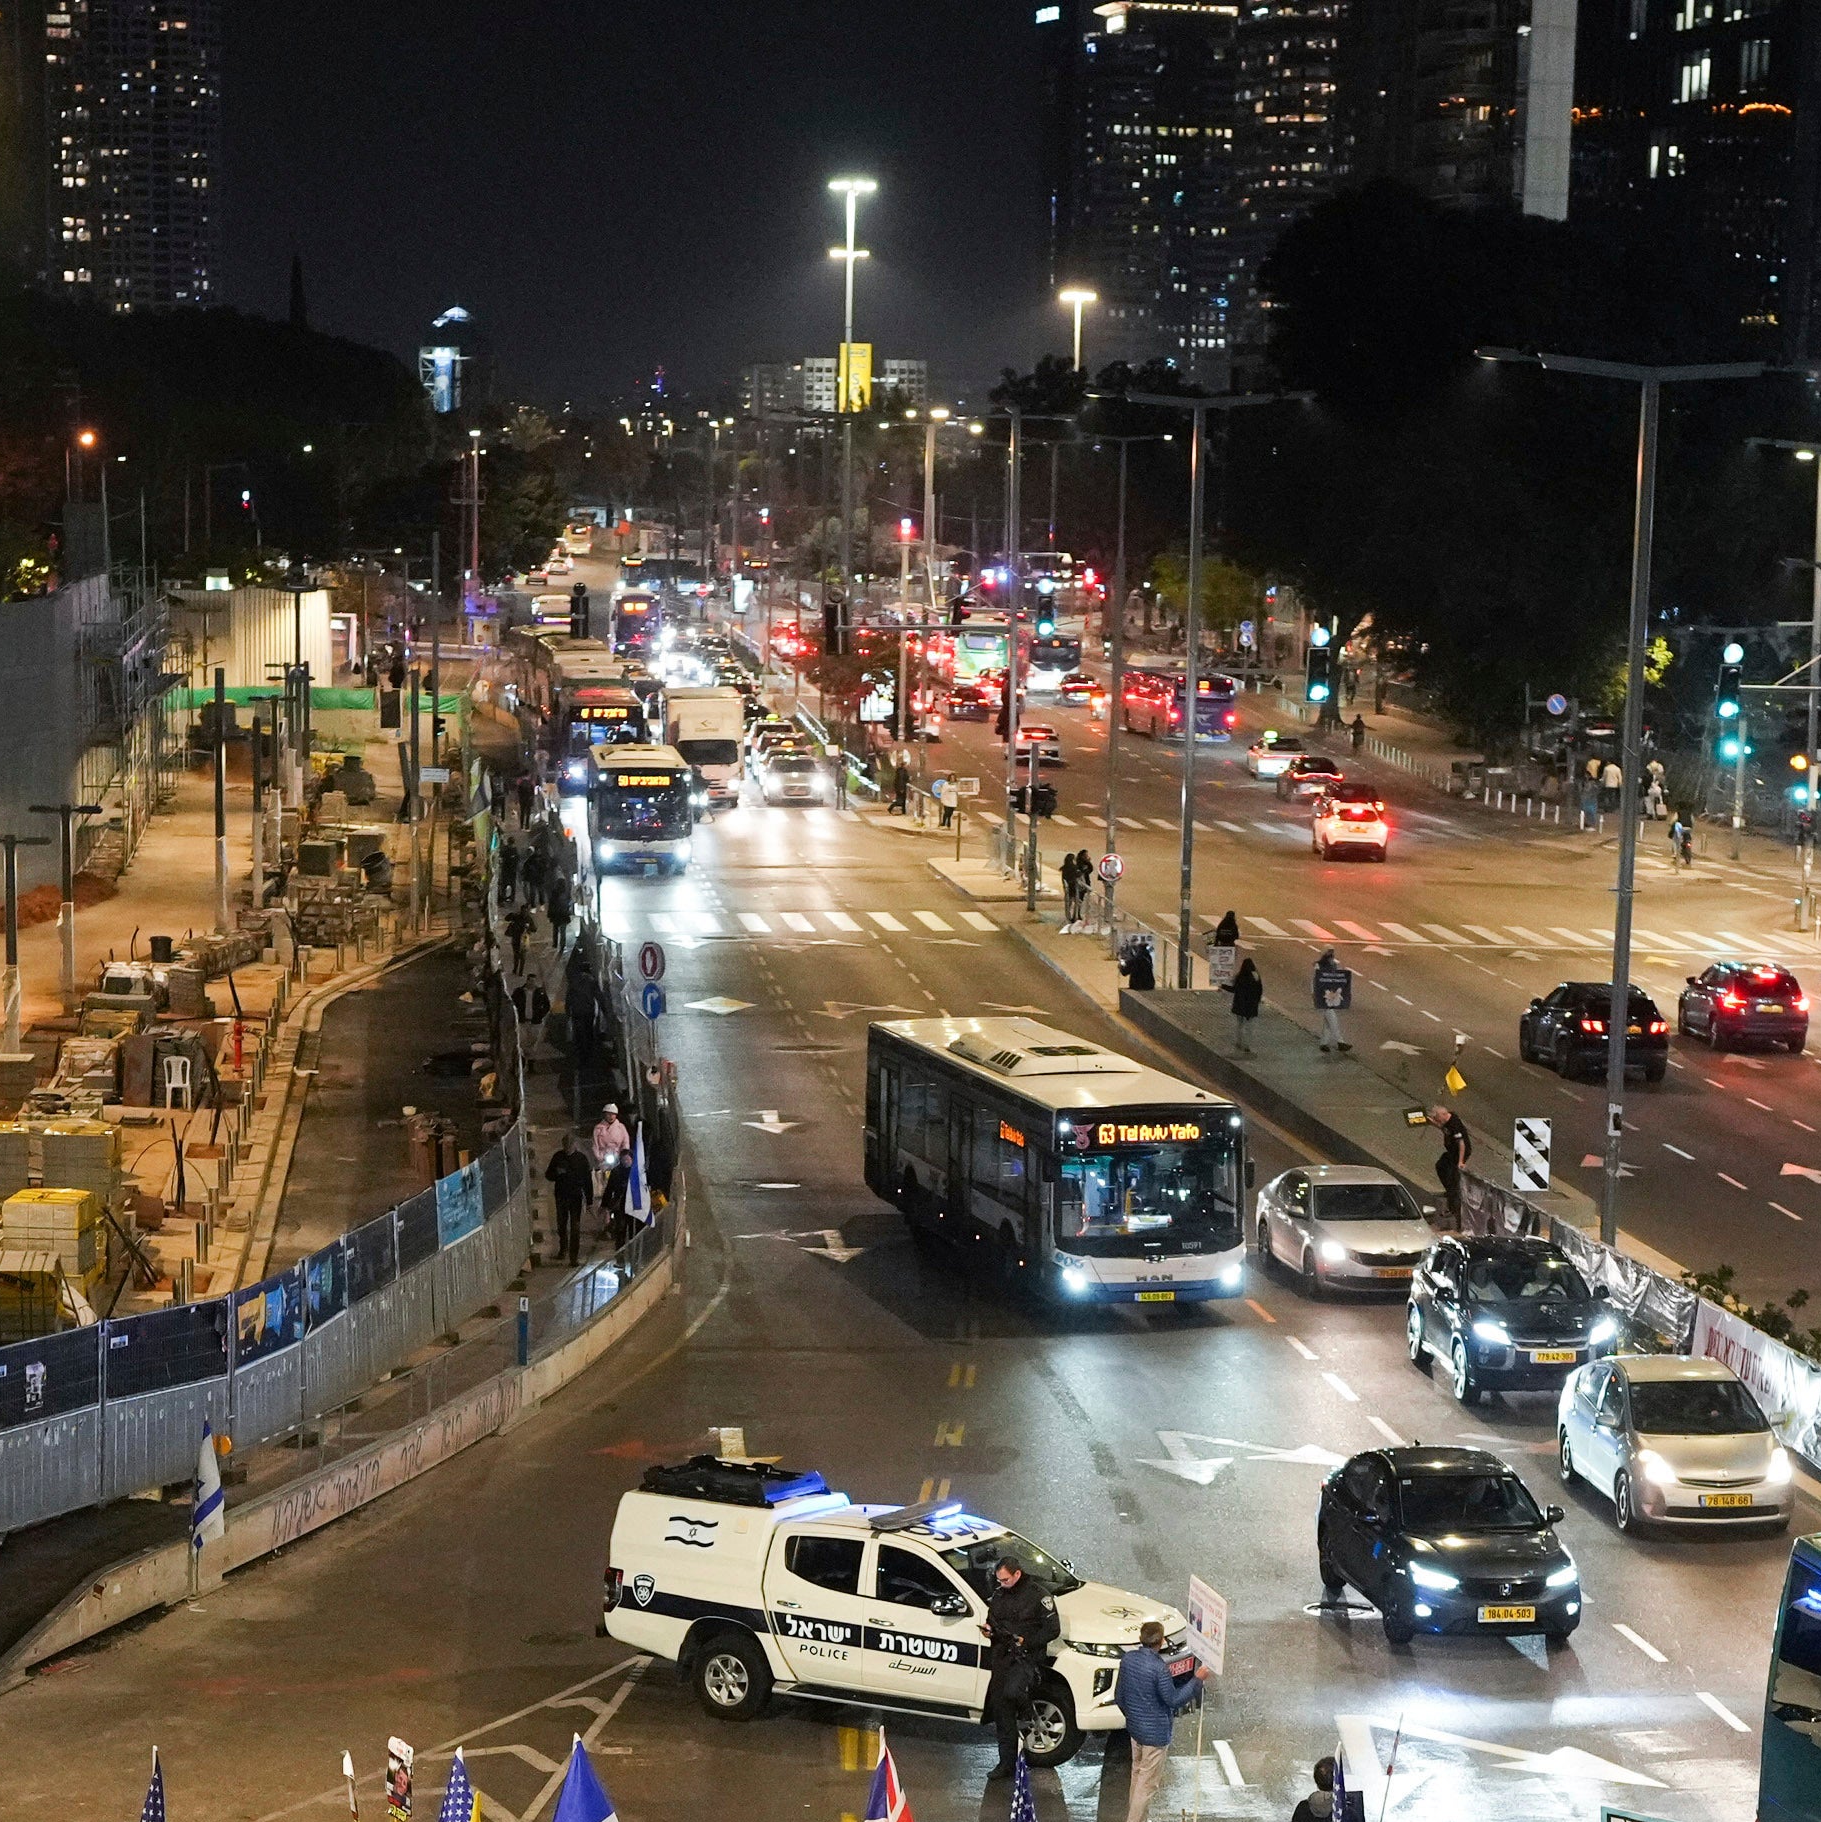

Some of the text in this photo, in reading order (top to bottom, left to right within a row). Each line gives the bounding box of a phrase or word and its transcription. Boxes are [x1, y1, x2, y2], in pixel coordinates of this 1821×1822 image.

[1099, 1123, 1199, 1144] 63 Tel Aviv Yafo
[785, 1614, 852, 1643] ישראל
[799, 1644, 849, 1661] POLICE
[878, 1632, 958, 1661] משטרת
[887, 1659, 937, 1677] الشرطة
